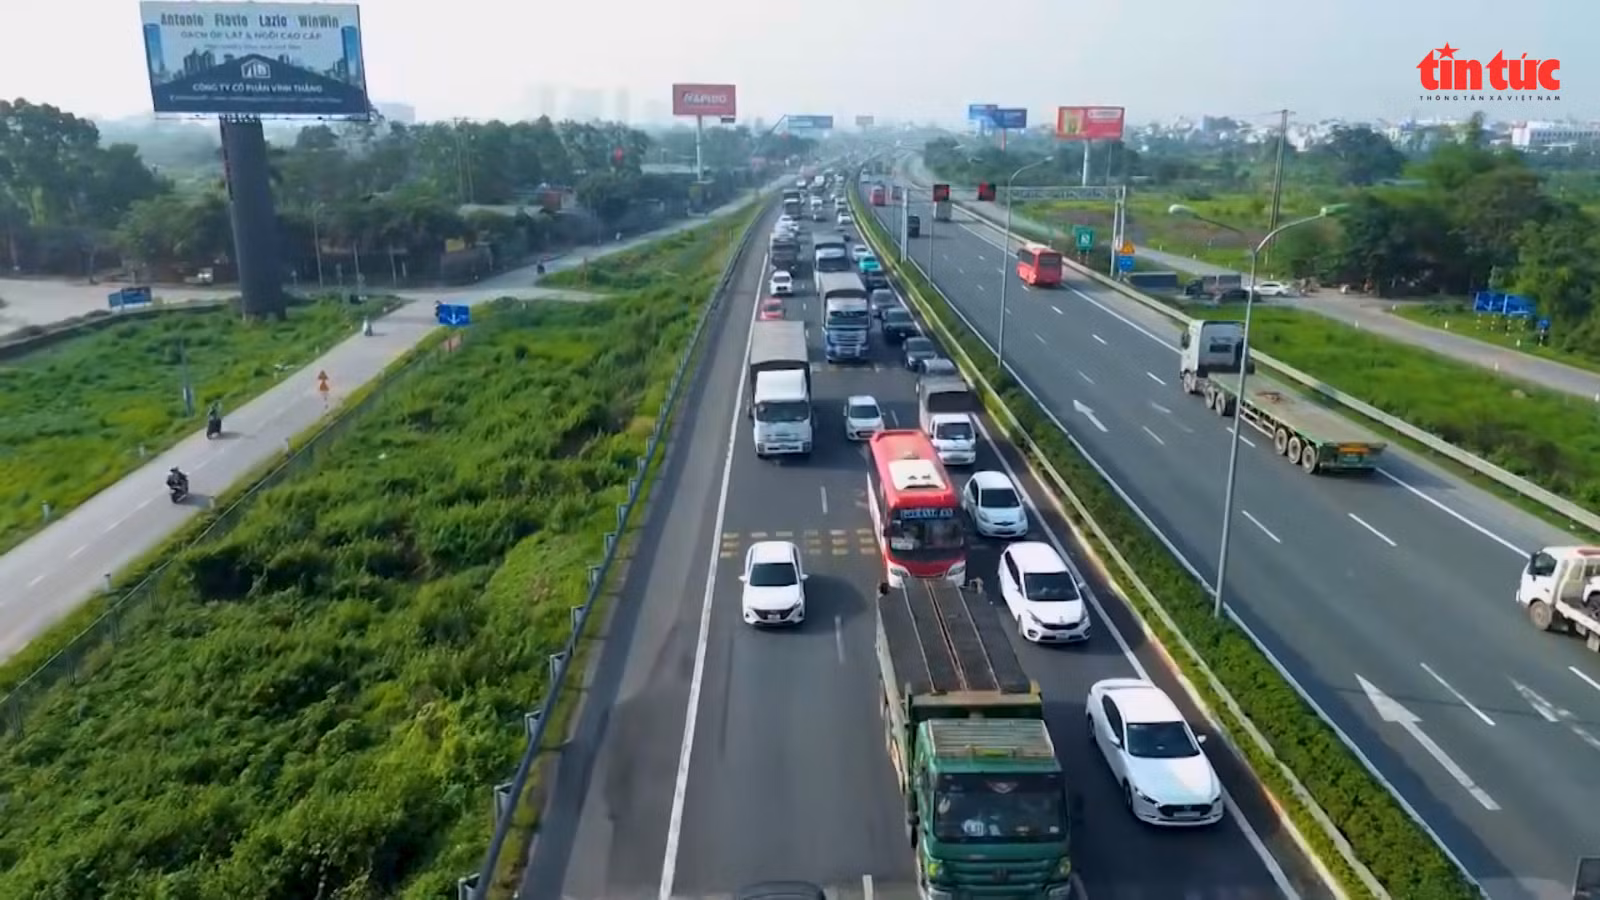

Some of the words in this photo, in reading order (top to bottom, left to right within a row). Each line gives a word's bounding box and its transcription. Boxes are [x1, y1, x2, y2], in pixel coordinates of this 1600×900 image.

[161, 13, 204, 26] Antonio
[215, 13, 248, 27] Flavio
[259, 15, 287, 28] Lazio
[298, 15, 339, 28] WinWin
[280, 31, 301, 40] CAO
[219, 83, 230, 92] TY
